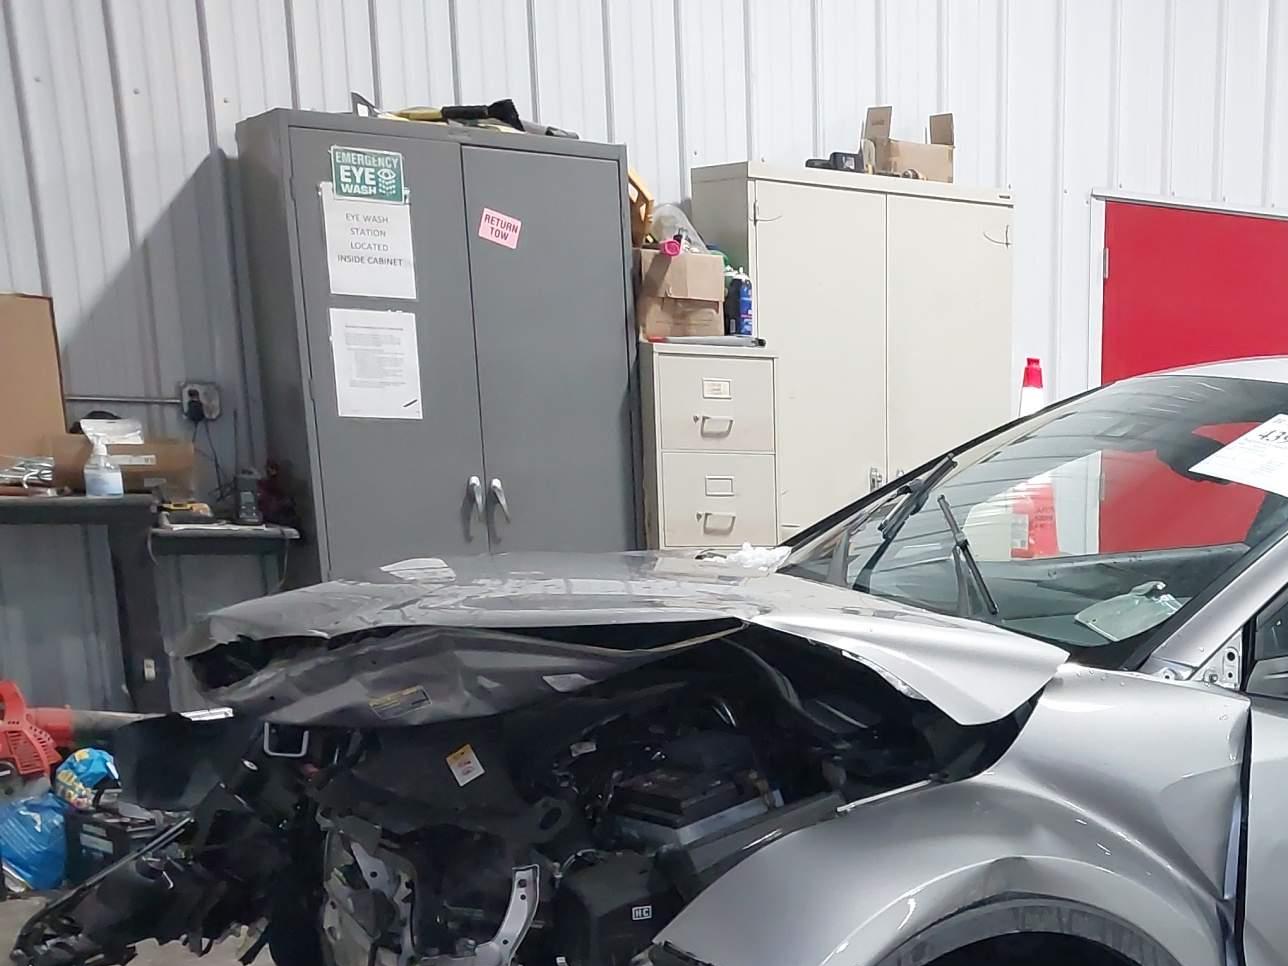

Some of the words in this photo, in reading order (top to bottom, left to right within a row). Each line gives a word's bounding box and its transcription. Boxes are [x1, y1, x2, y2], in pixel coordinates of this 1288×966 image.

[335, 151, 398, 168] EMERGENCY
[340, 165, 376, 185] EYE
[340, 183, 377, 194] WASH
[345, 212, 361, 222] EYE
[362, 214, 389, 223] WASH
[484, 213, 519, 234] RETURN
[350, 227, 386, 237] STATION
[490, 226, 509, 241] TOW
[350, 241, 389, 252] LOCATED
[337, 254, 365, 264] INSIDE
[366, 256, 403, 267] CABINET
